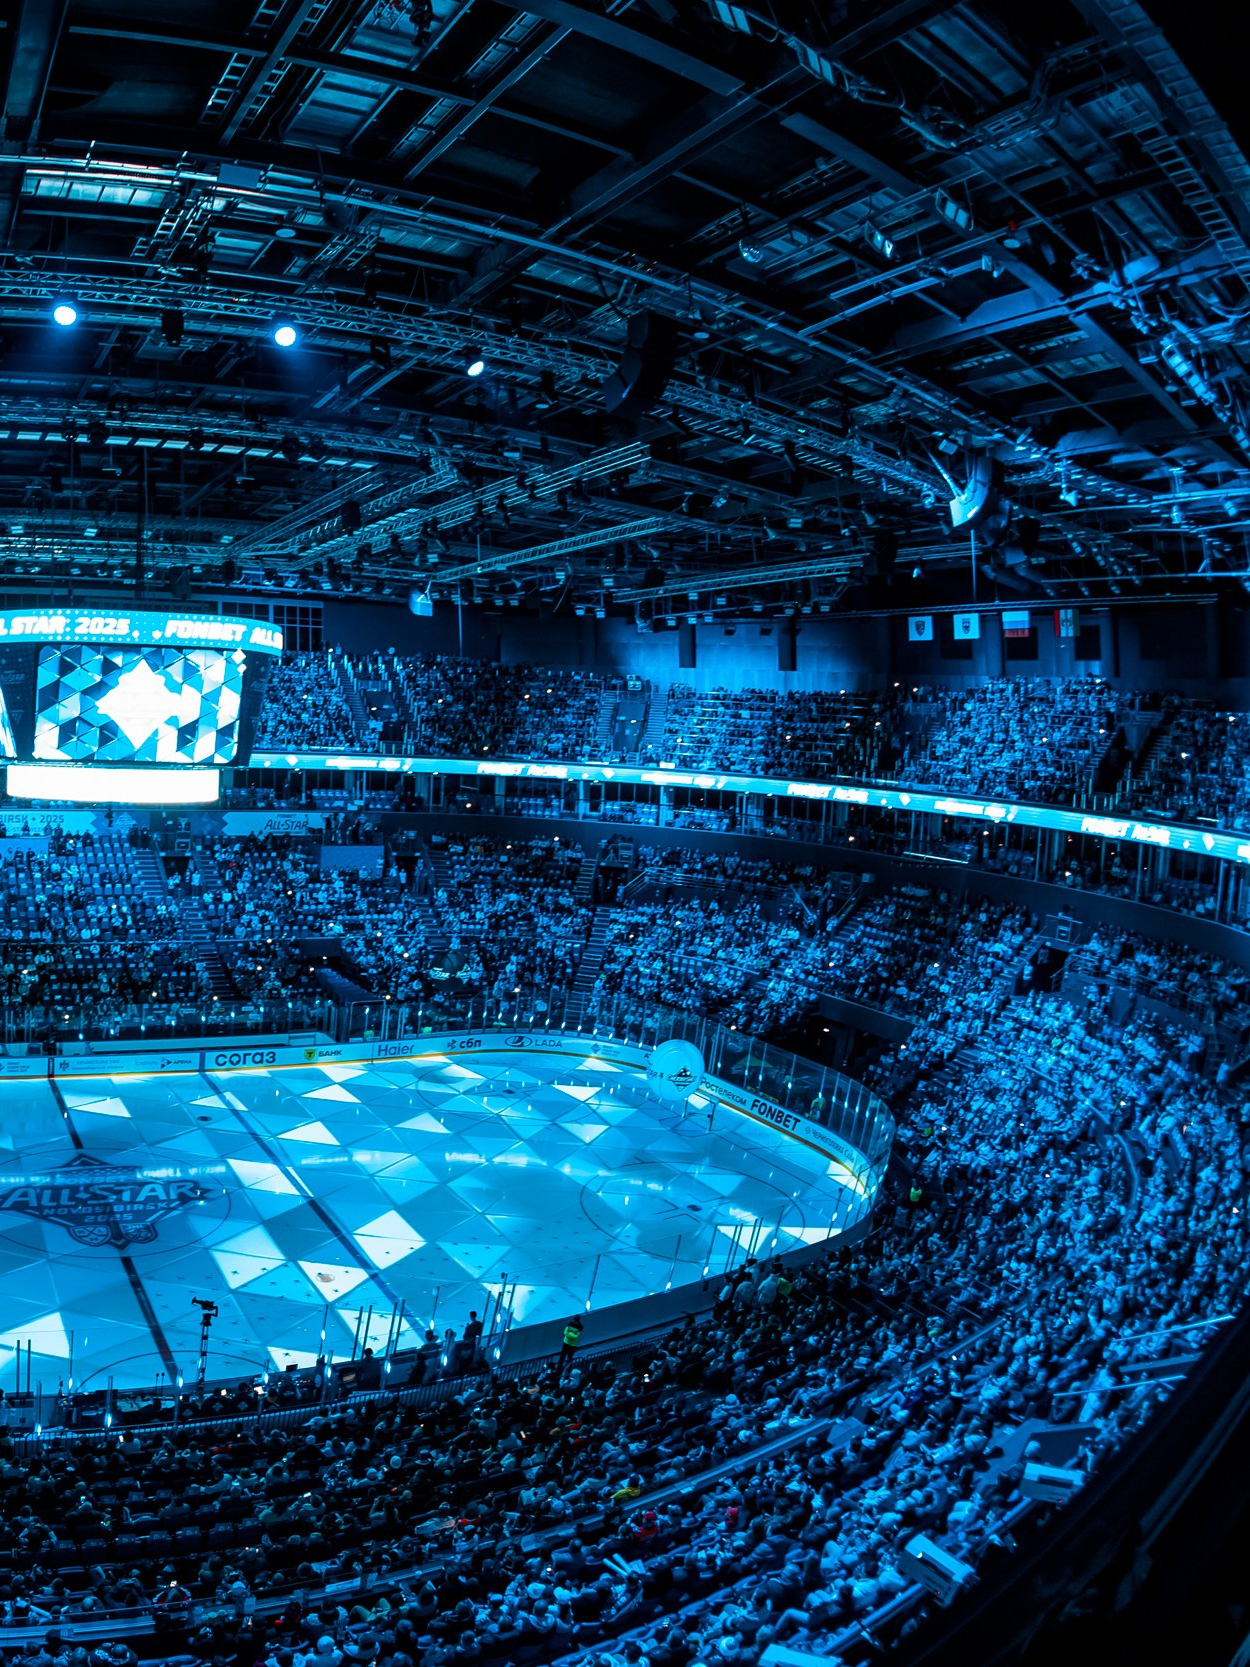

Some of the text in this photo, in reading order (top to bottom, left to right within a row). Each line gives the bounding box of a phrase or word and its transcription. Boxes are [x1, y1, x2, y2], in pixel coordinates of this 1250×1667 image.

[9, 615, 68, 635] STAR
[74, 617, 130, 636] 2025
[164, 620, 247, 642] FONBET
[39, 814, 65, 823] 2025
[535, 1038, 563, 1048] LADA
[318, 1049, 342, 1058] БАНК
[377, 1043, 415, 1057] Haier
[701, 1077, 747, 1106] Ростелеком
[750, 1098, 802, 1132] FONBET
[42, 1202, 170, 1215] NOVOSIBIRSK
[84, 1213, 133, 1223] 2025
